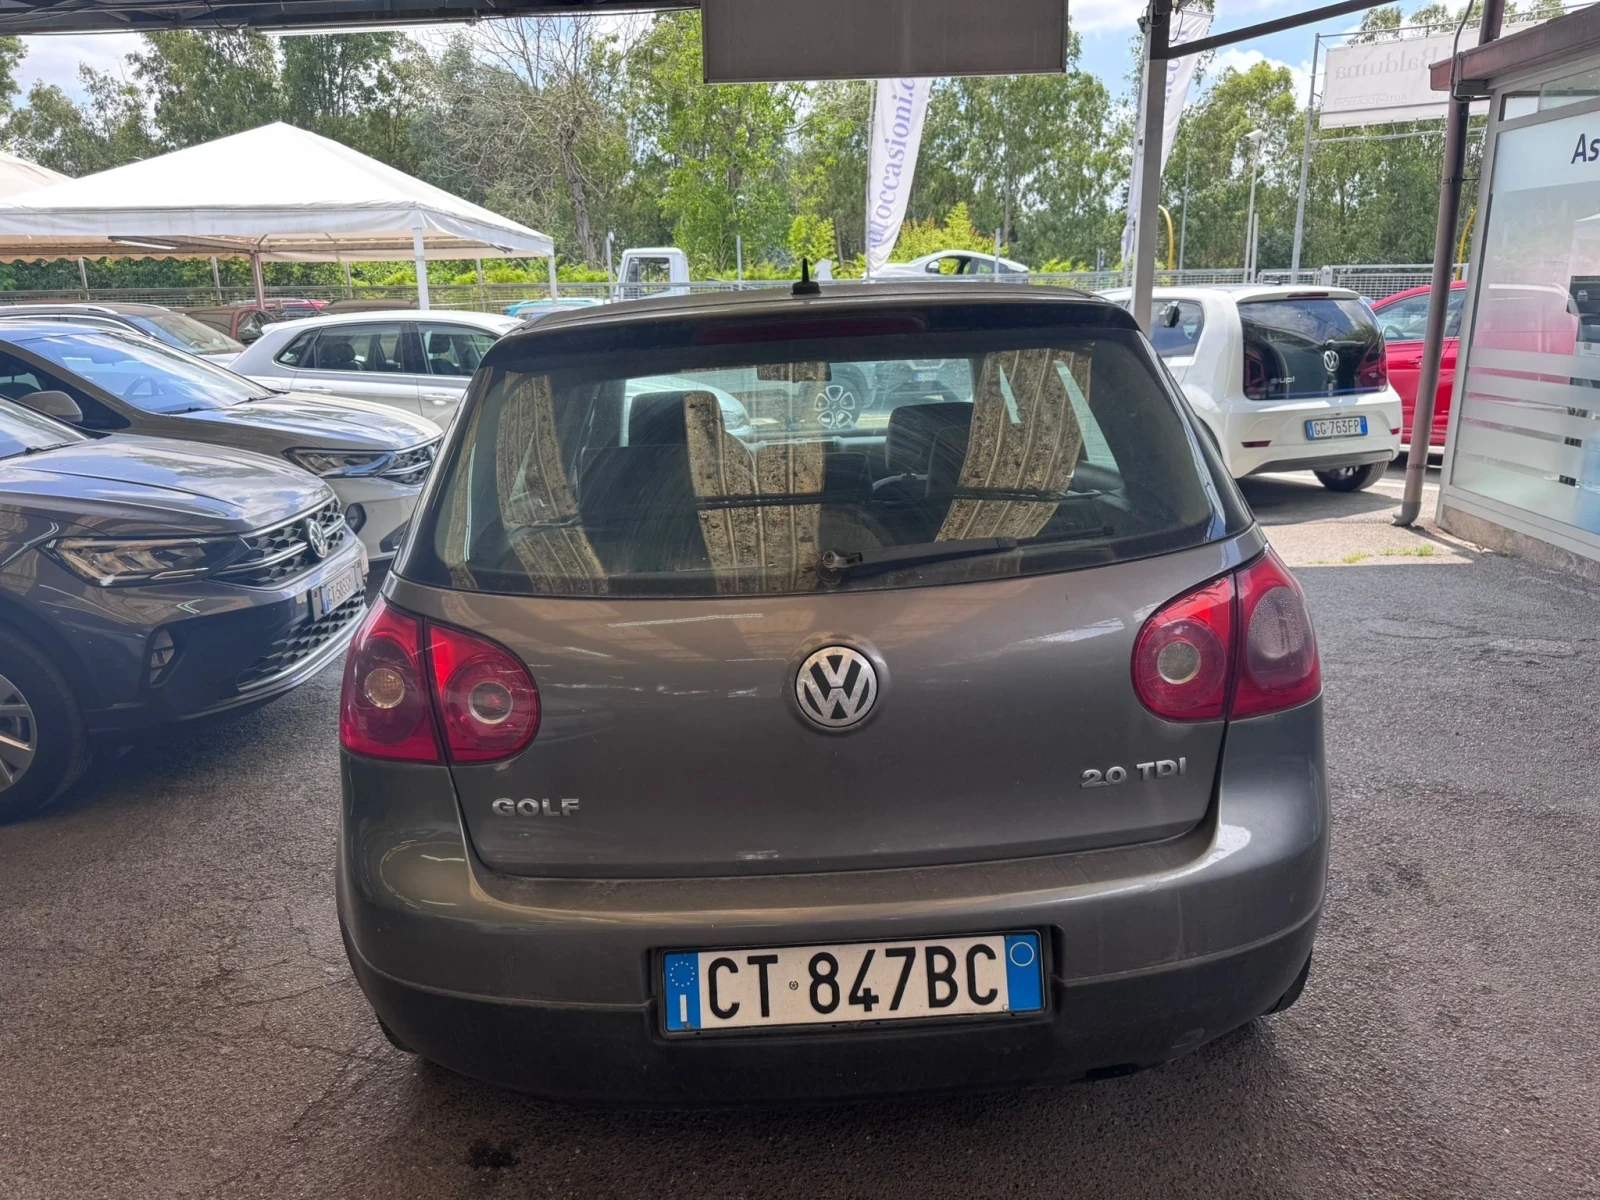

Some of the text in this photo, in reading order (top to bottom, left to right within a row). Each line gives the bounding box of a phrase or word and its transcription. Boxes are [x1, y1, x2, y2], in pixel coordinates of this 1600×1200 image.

[1314, 422, 1327, 436] GG
[1329, 419, 1360, 434] 763FP
[1136, 757, 1187, 781] TDI
[492, 798, 580, 817] GOLF
[708, 954, 779, 1019] CT
[808, 943, 998, 1015] 847BC
